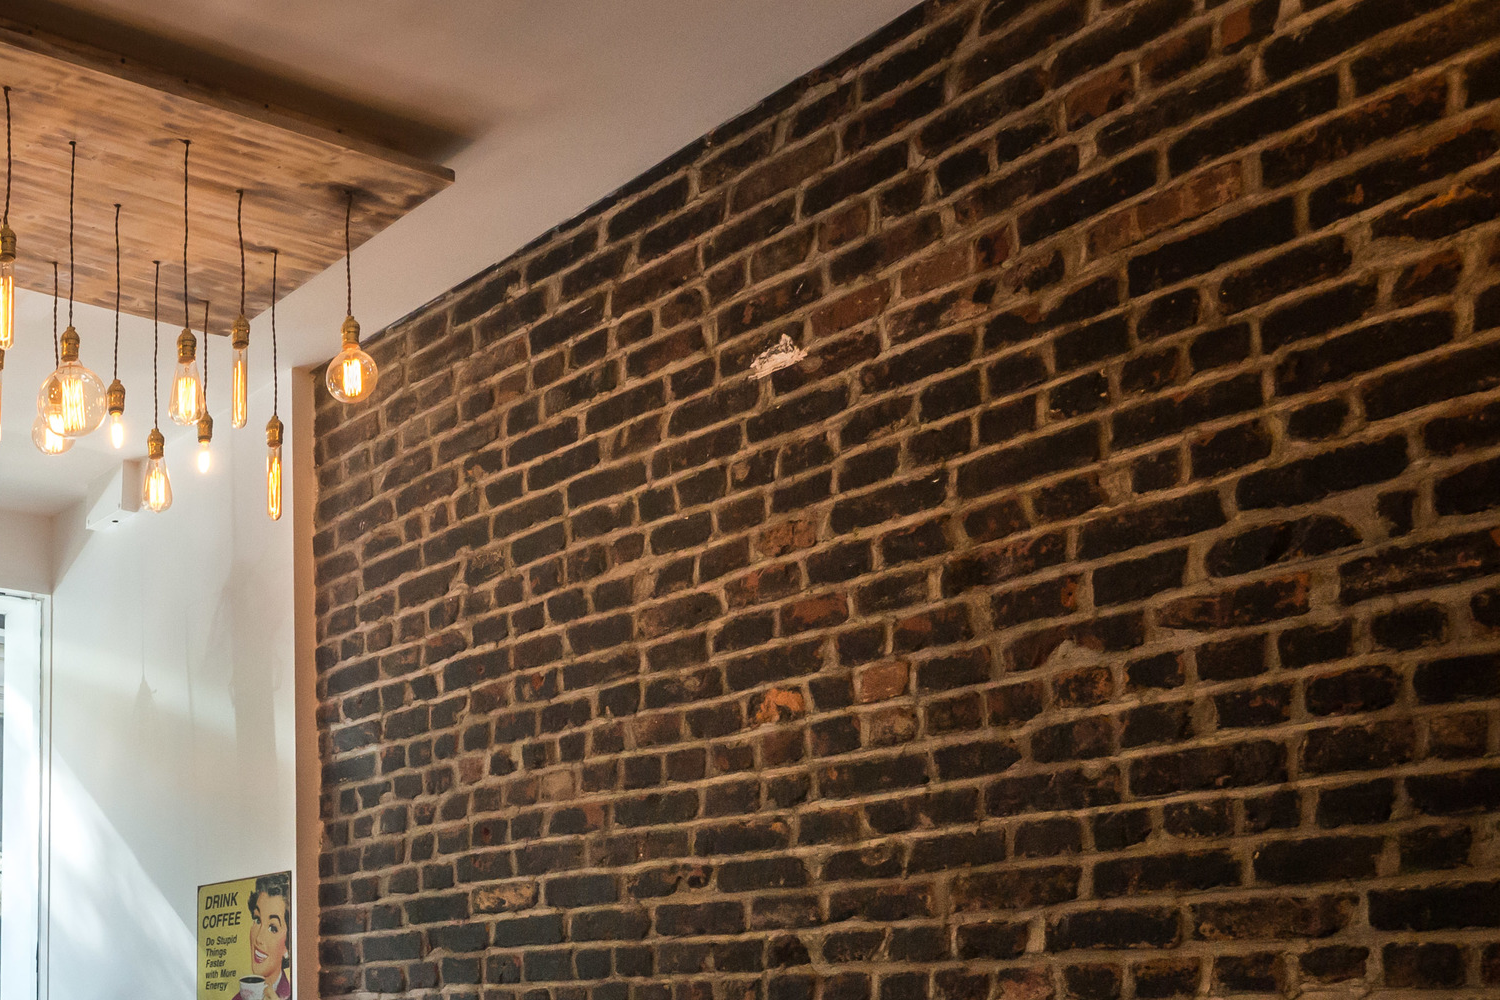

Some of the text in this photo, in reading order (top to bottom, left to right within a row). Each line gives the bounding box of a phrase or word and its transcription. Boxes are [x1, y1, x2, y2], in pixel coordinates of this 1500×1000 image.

[205, 892, 239, 910] DRINK
[202, 911, 242, 930] COFFEE
[206, 934, 238, 947] Do Stupid
[205, 947, 227, 959] Things
[205, 959, 226, 968] Faster
[205, 968, 237, 979] with More
[205, 981, 229, 992] Energy
